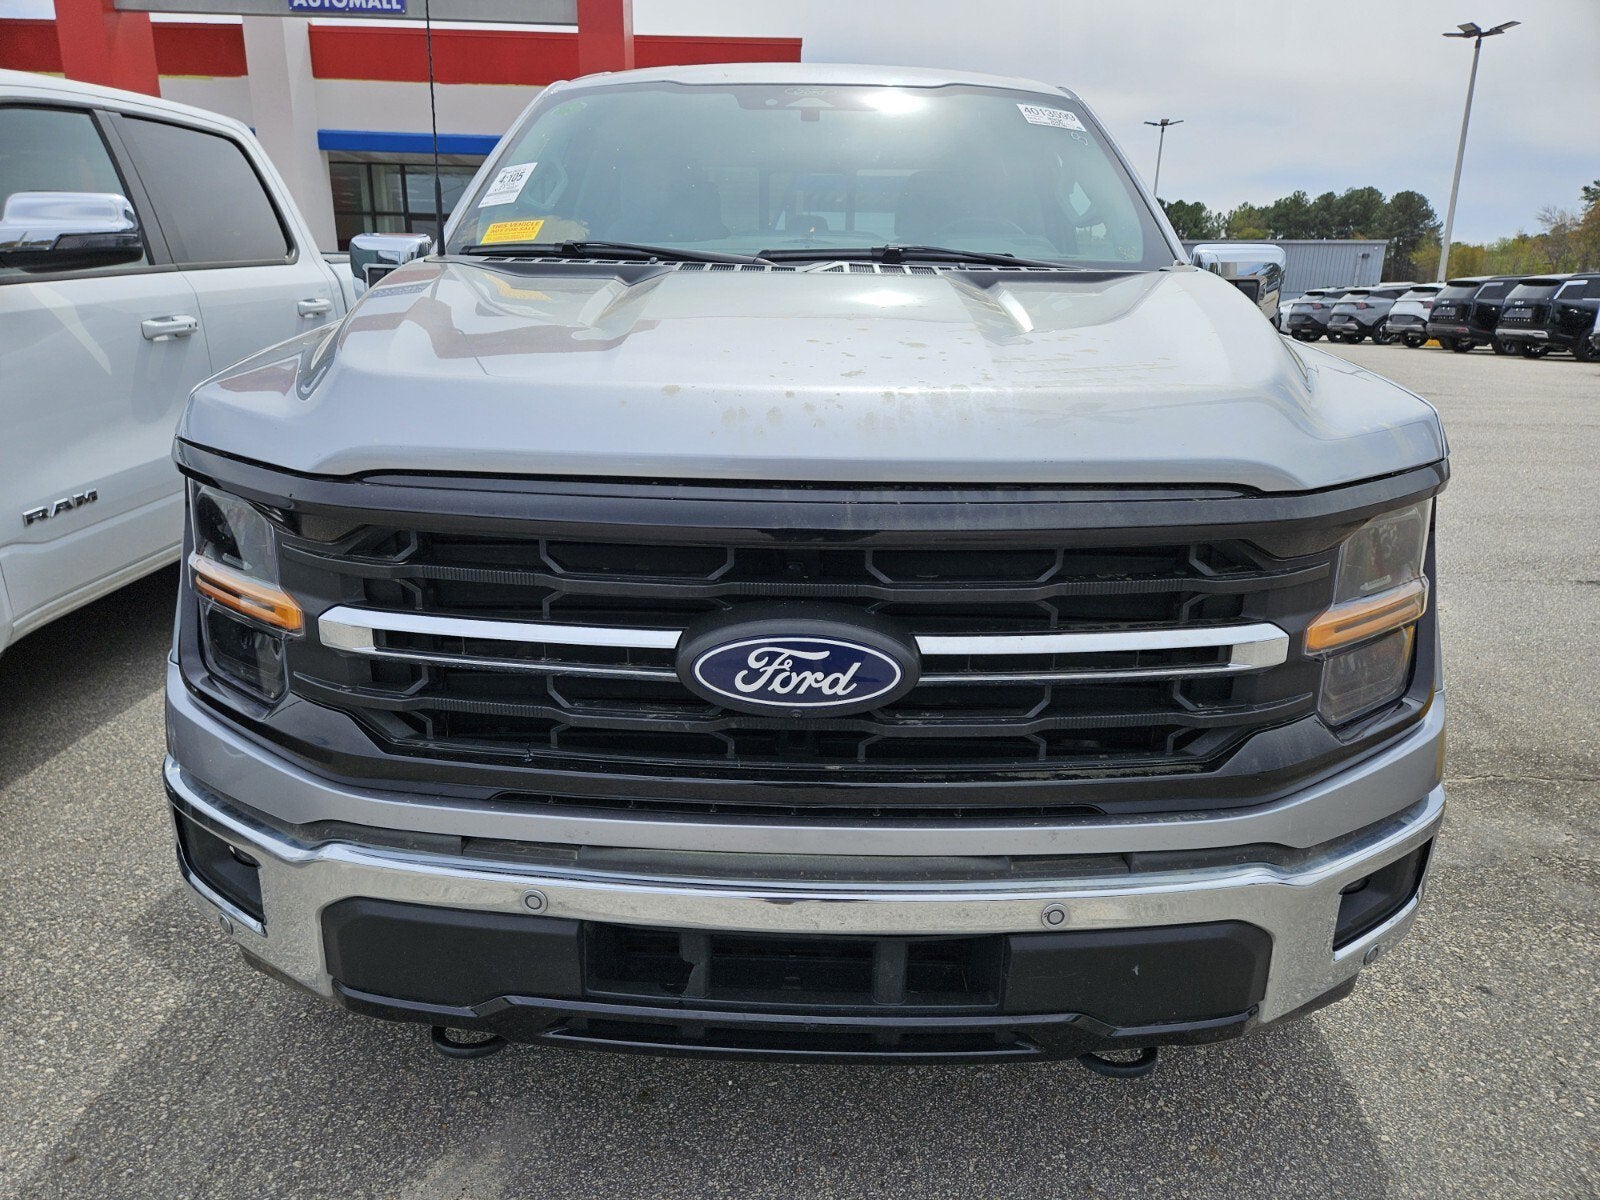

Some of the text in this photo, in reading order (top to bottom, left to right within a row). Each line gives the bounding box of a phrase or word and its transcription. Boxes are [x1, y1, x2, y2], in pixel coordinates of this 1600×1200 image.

[293, 0, 401, 9] AUTOMALL
[22, 488, 98, 527] RAM
[734, 646, 862, 696] Ford
